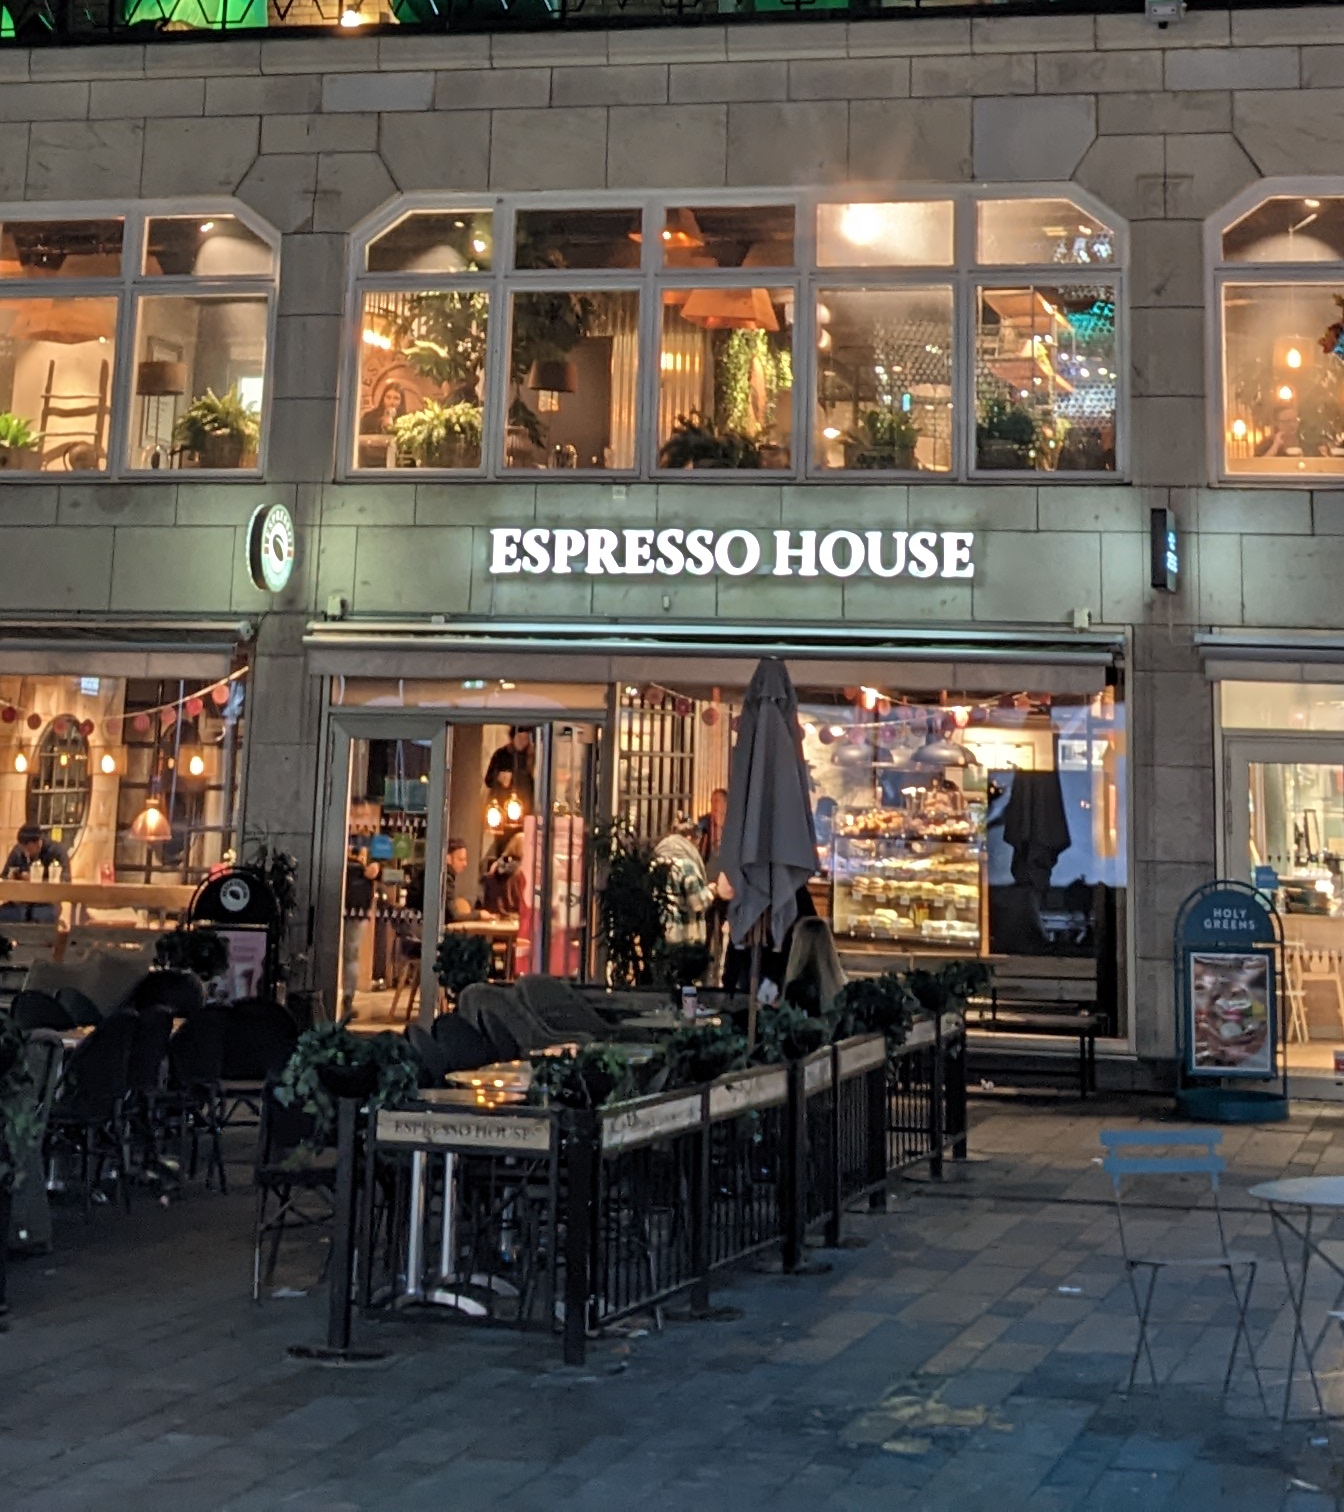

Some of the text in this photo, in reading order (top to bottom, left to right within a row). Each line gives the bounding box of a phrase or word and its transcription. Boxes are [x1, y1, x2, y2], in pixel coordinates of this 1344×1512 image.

[490, 528, 975, 578] ESPRESSO HOUSE
[1213, 907, 1247, 919] HOLY
[1204, 918, 1255, 931] GREENS
[475, 1122, 529, 1142] HOUSE
